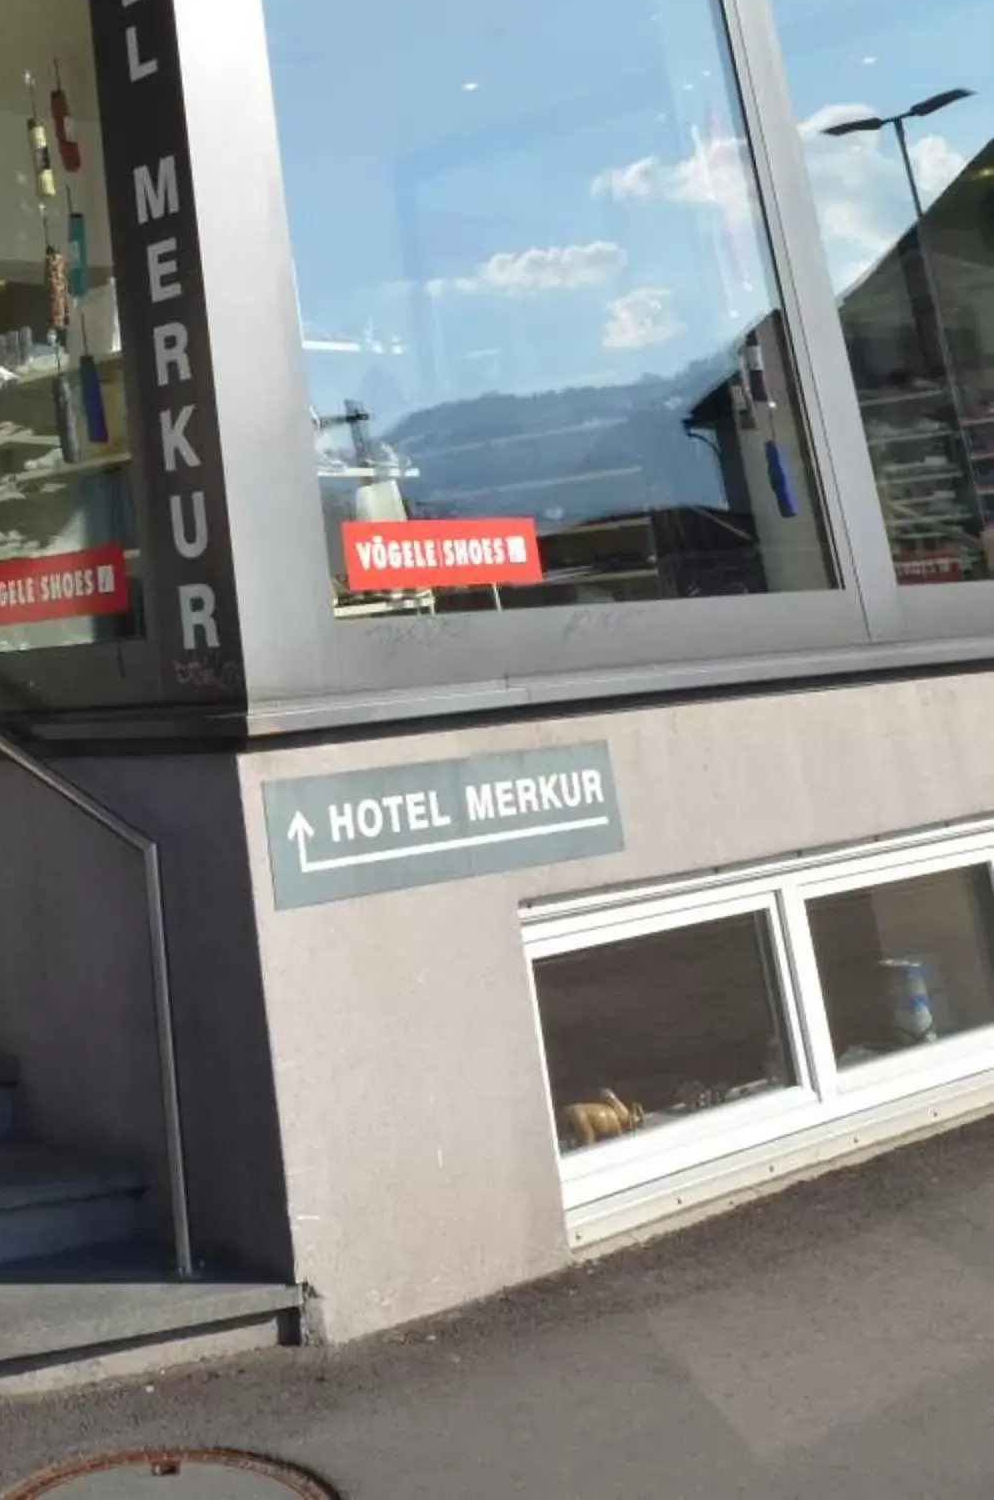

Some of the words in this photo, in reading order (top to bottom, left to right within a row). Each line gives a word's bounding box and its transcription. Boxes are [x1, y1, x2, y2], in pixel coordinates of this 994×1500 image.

[133, 155, 220, 650] MERKUR
[443, 536, 504, 567] SHOES
[40, 568, 94, 601] SHOES
[328, 790, 451, 842] HOTEL
[465, 769, 604, 821] MERKUR
